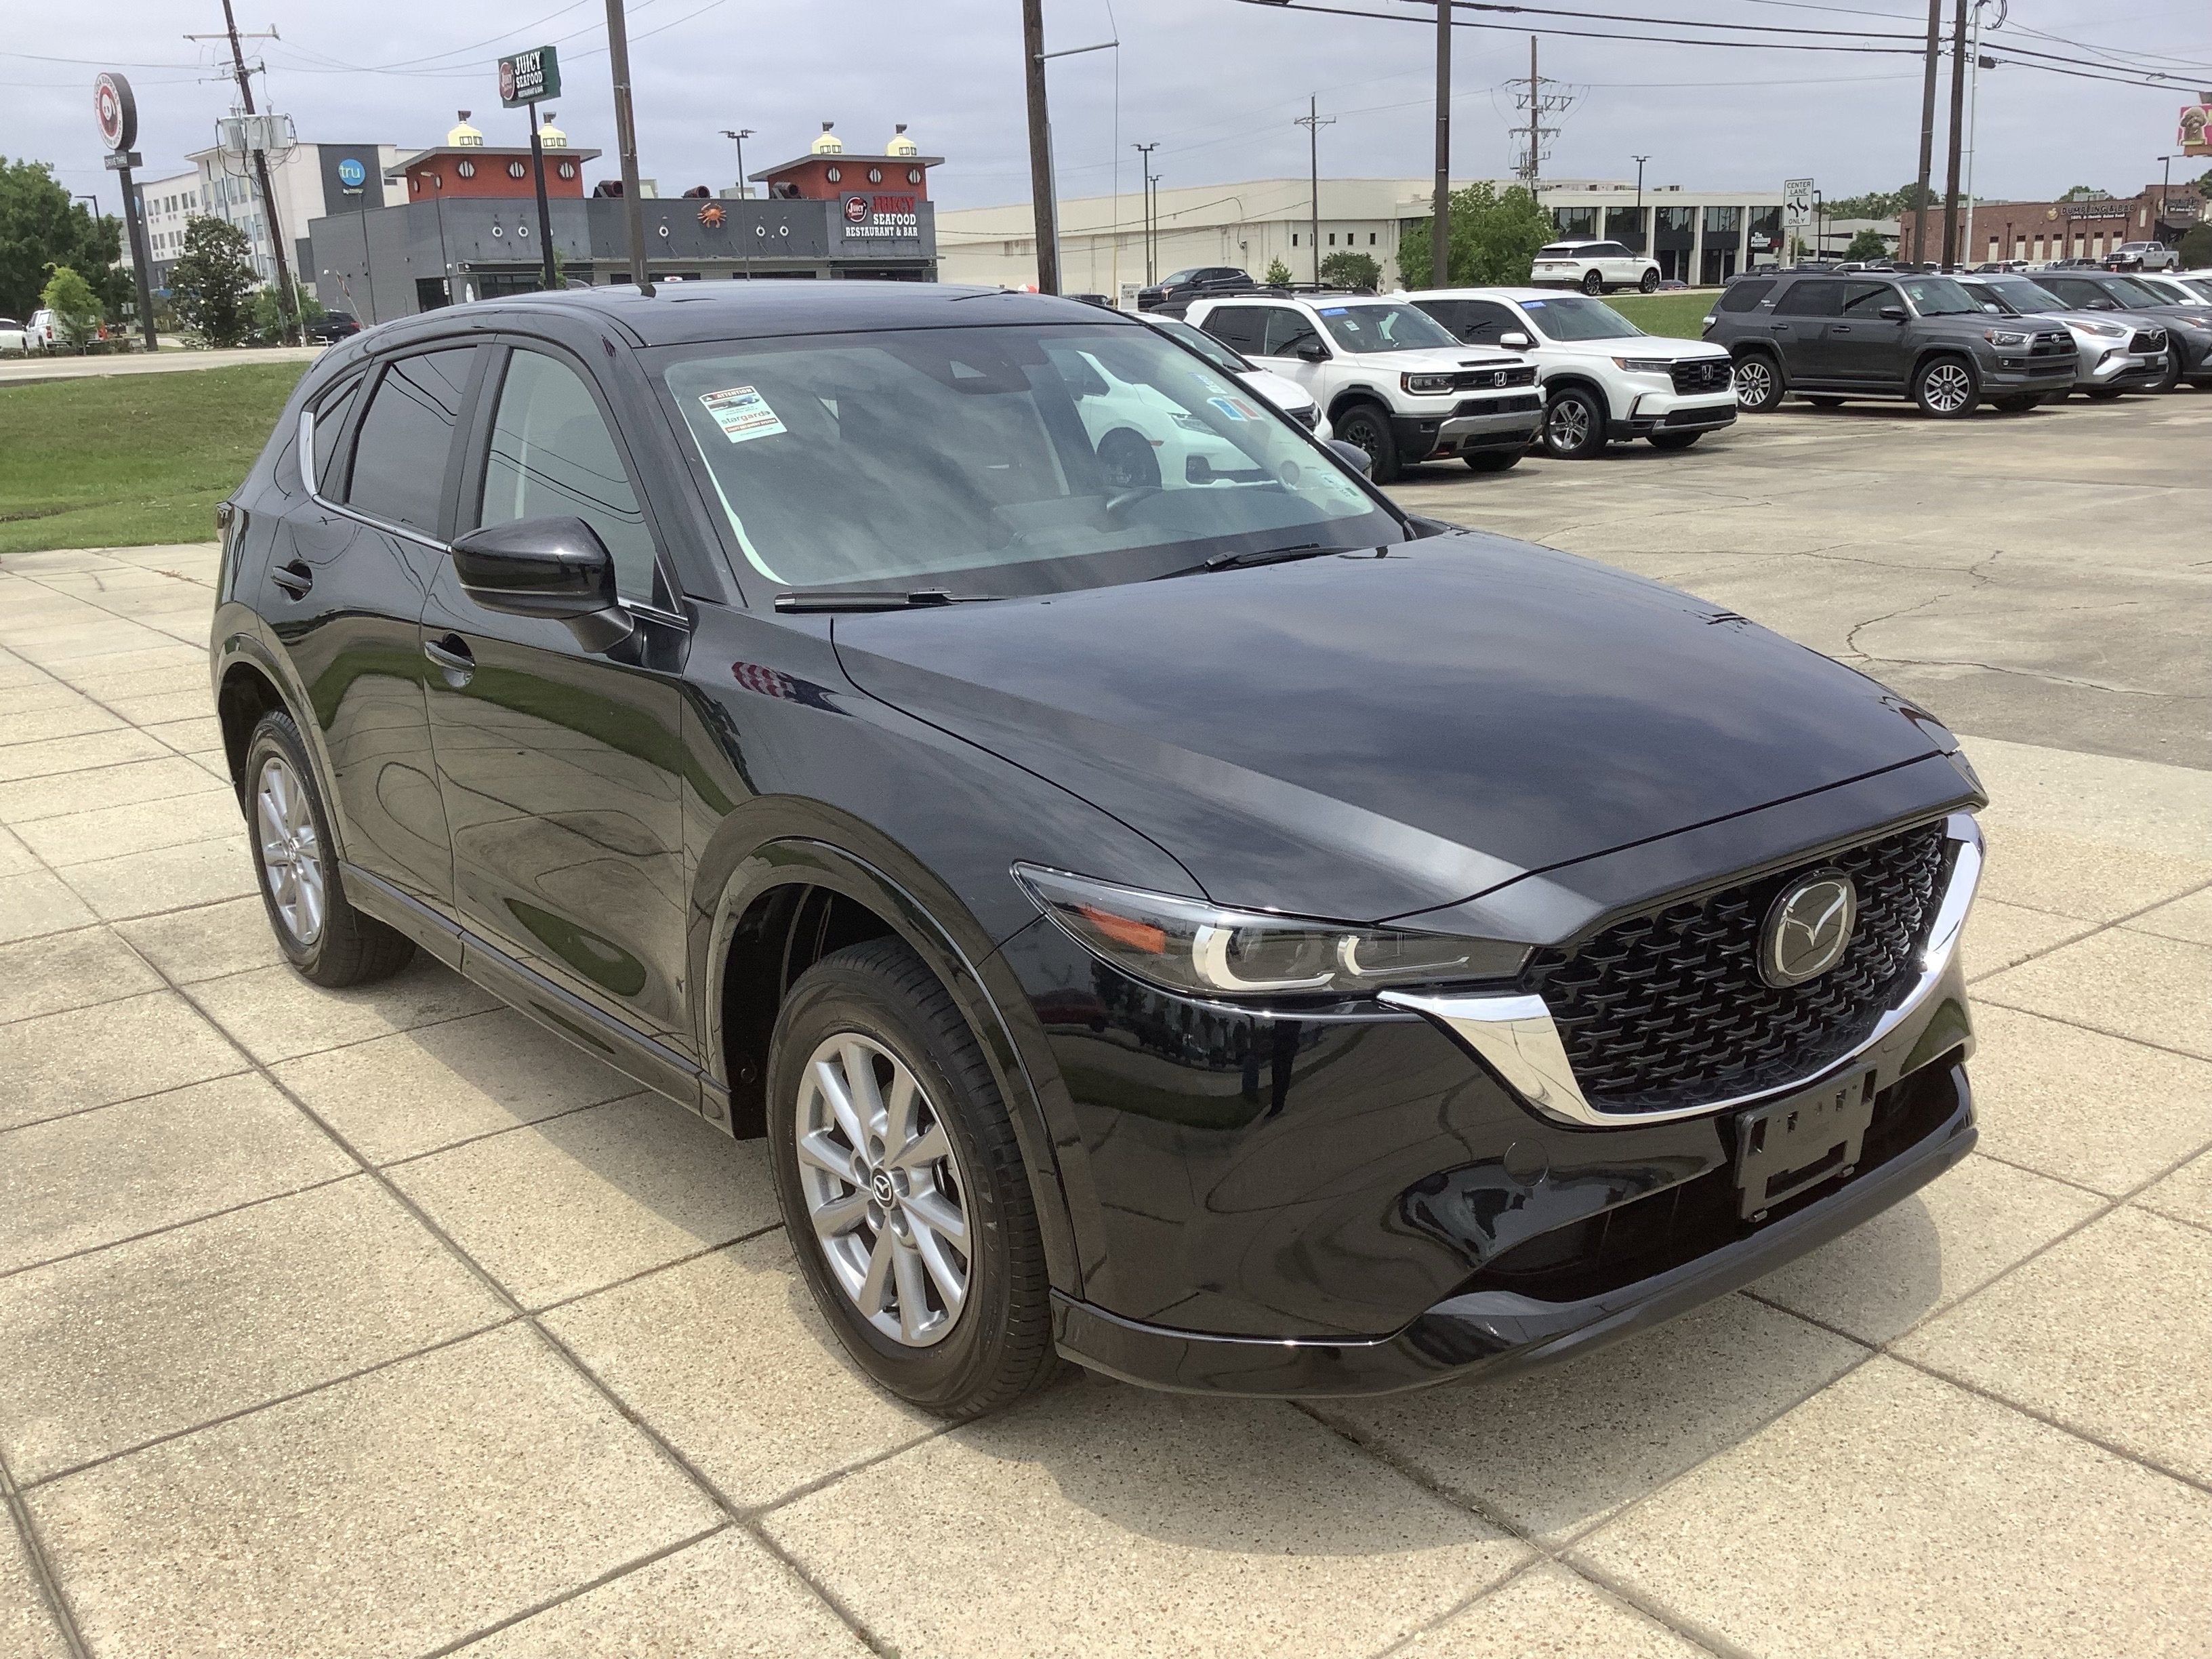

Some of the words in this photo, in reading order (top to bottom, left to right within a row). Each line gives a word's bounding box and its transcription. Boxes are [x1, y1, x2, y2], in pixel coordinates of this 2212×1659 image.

[515, 52, 540, 75] JUICY
[516, 70, 543, 89] SEAFOOD
[338, 165, 361, 178] tru
[1786, 181, 1811, 189] CENTER
[870, 195, 914, 213] JUICY
[873, 213, 916, 226] SEAFOOD
[845, 226, 895, 237] RESTAURANT
[896, 226, 901, 237] &
[903, 226, 918, 237] BAR
[716, 388, 753, 398] ATTENTION
